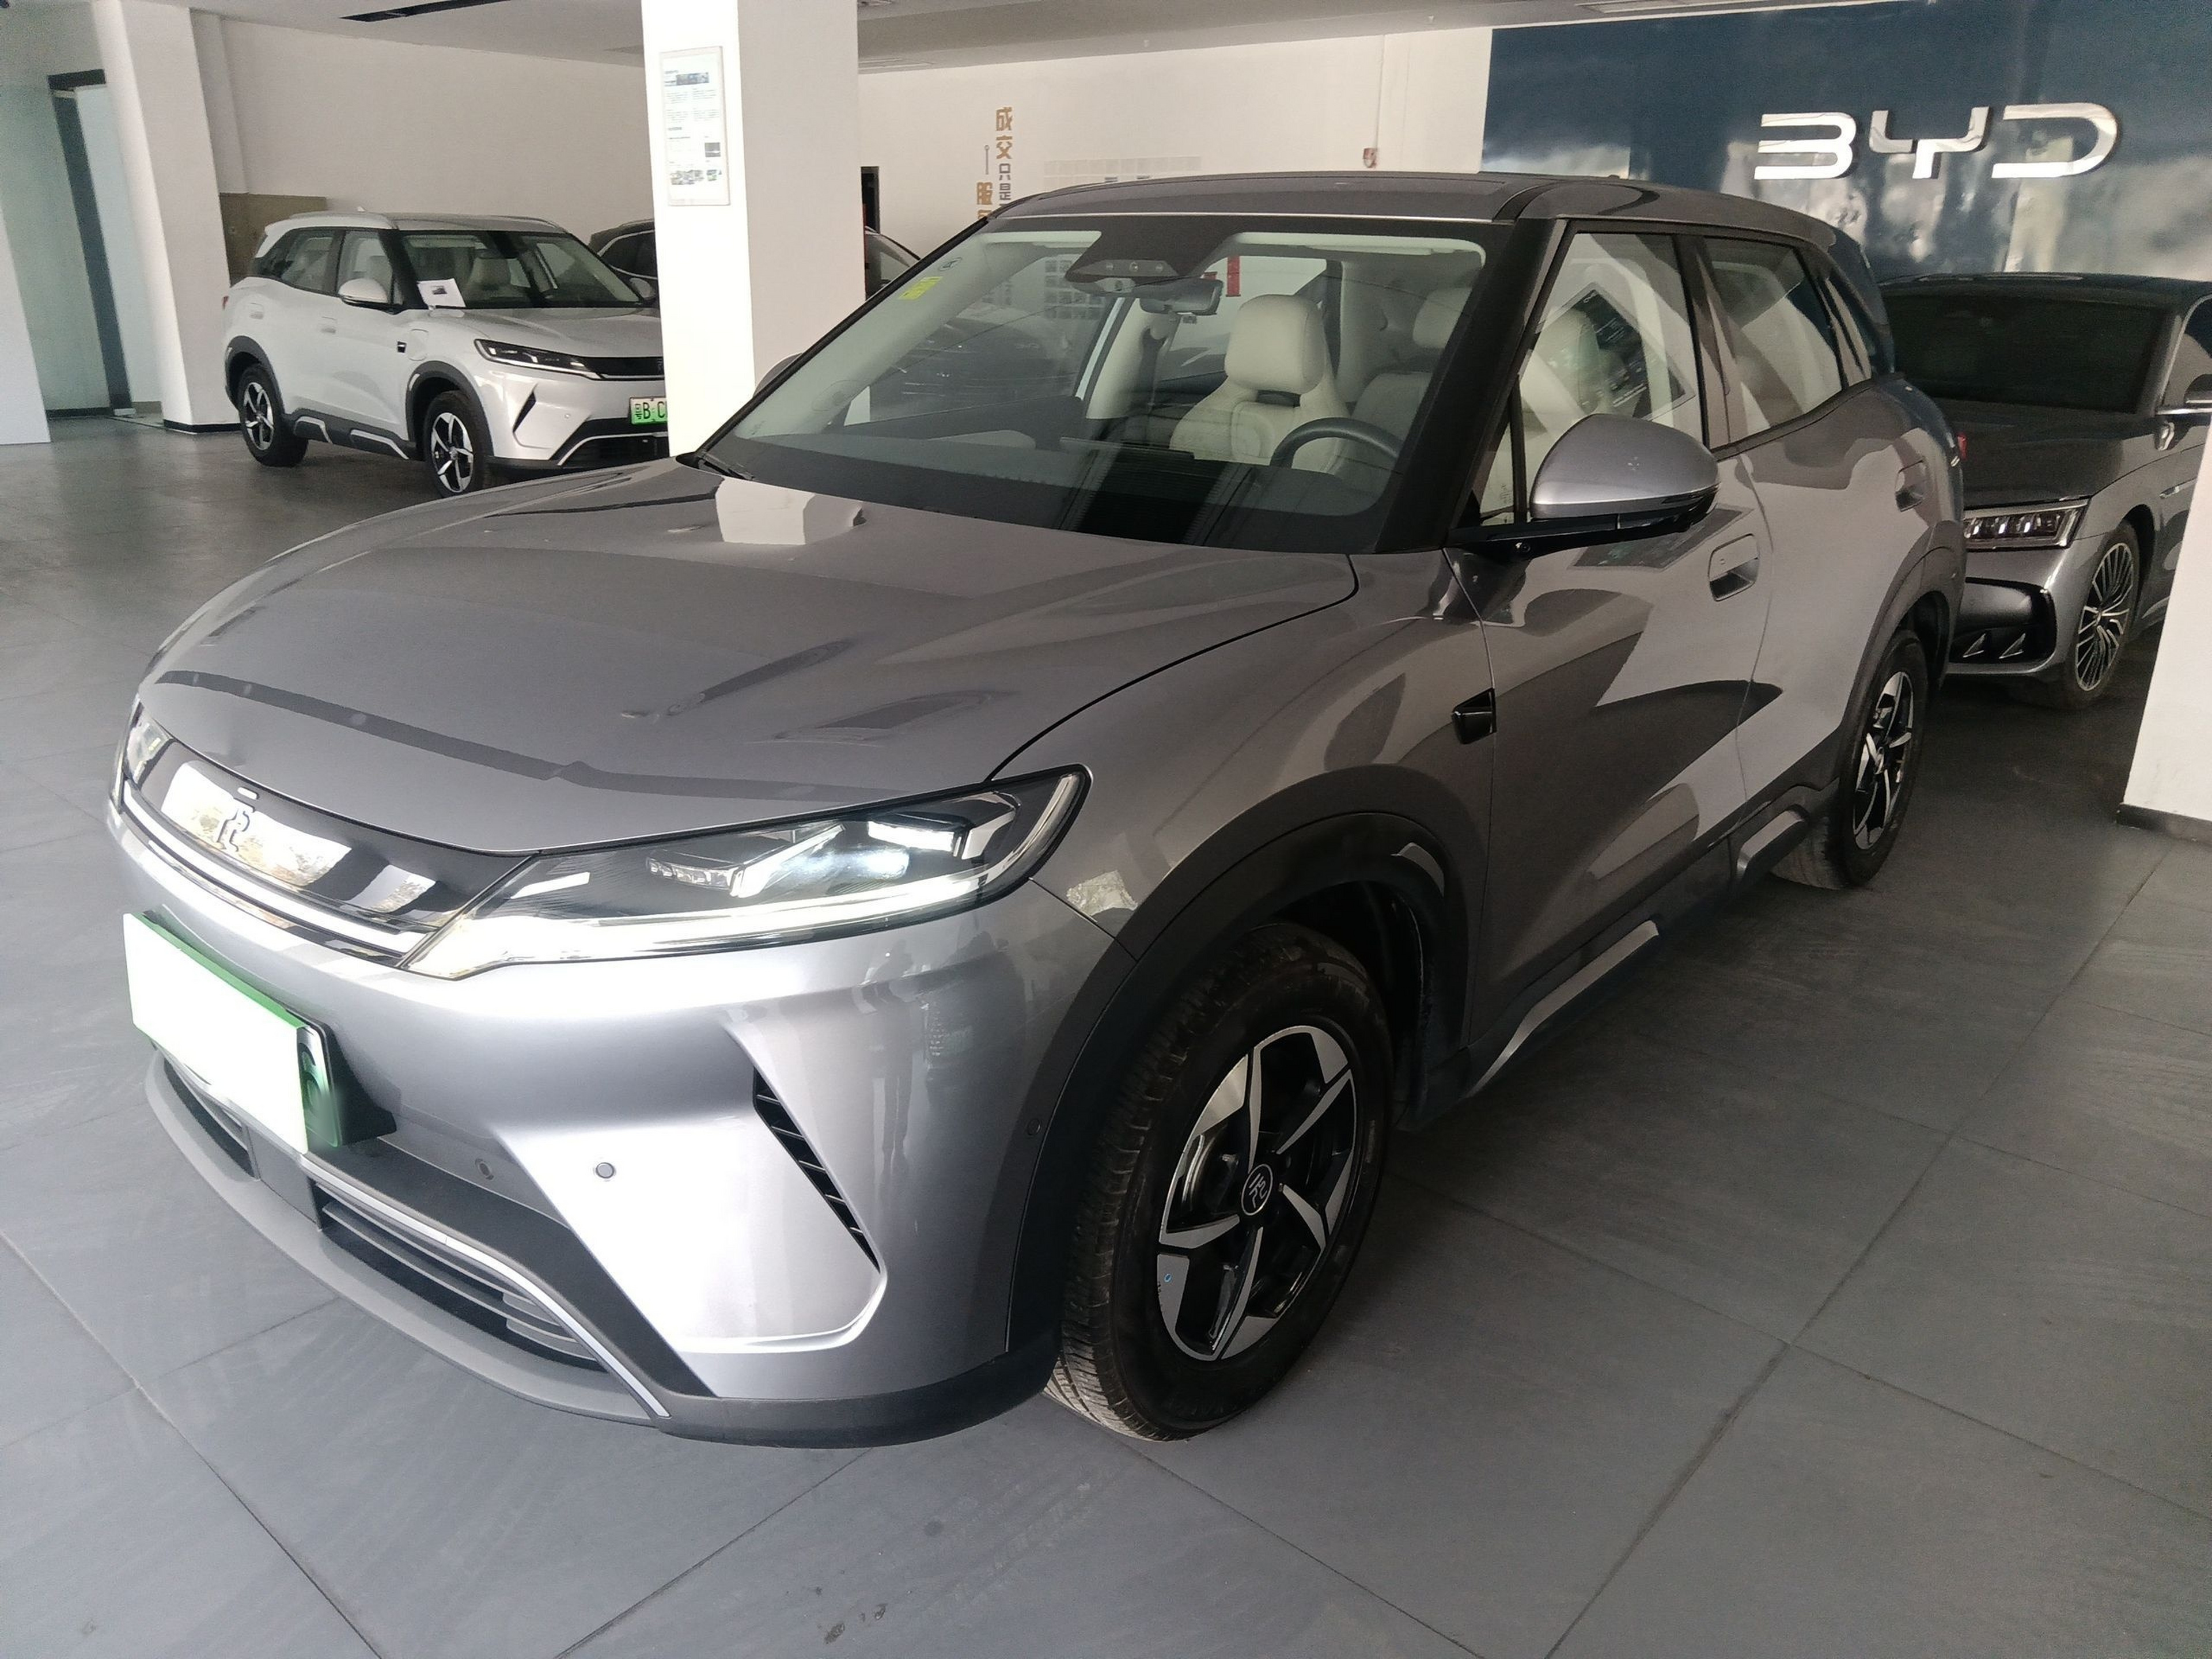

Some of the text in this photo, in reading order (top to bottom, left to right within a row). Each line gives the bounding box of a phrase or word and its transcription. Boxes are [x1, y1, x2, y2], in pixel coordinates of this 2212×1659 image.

[995, 107, 1012, 208] 成交只是
[1754, 103, 2118, 180] BYD
